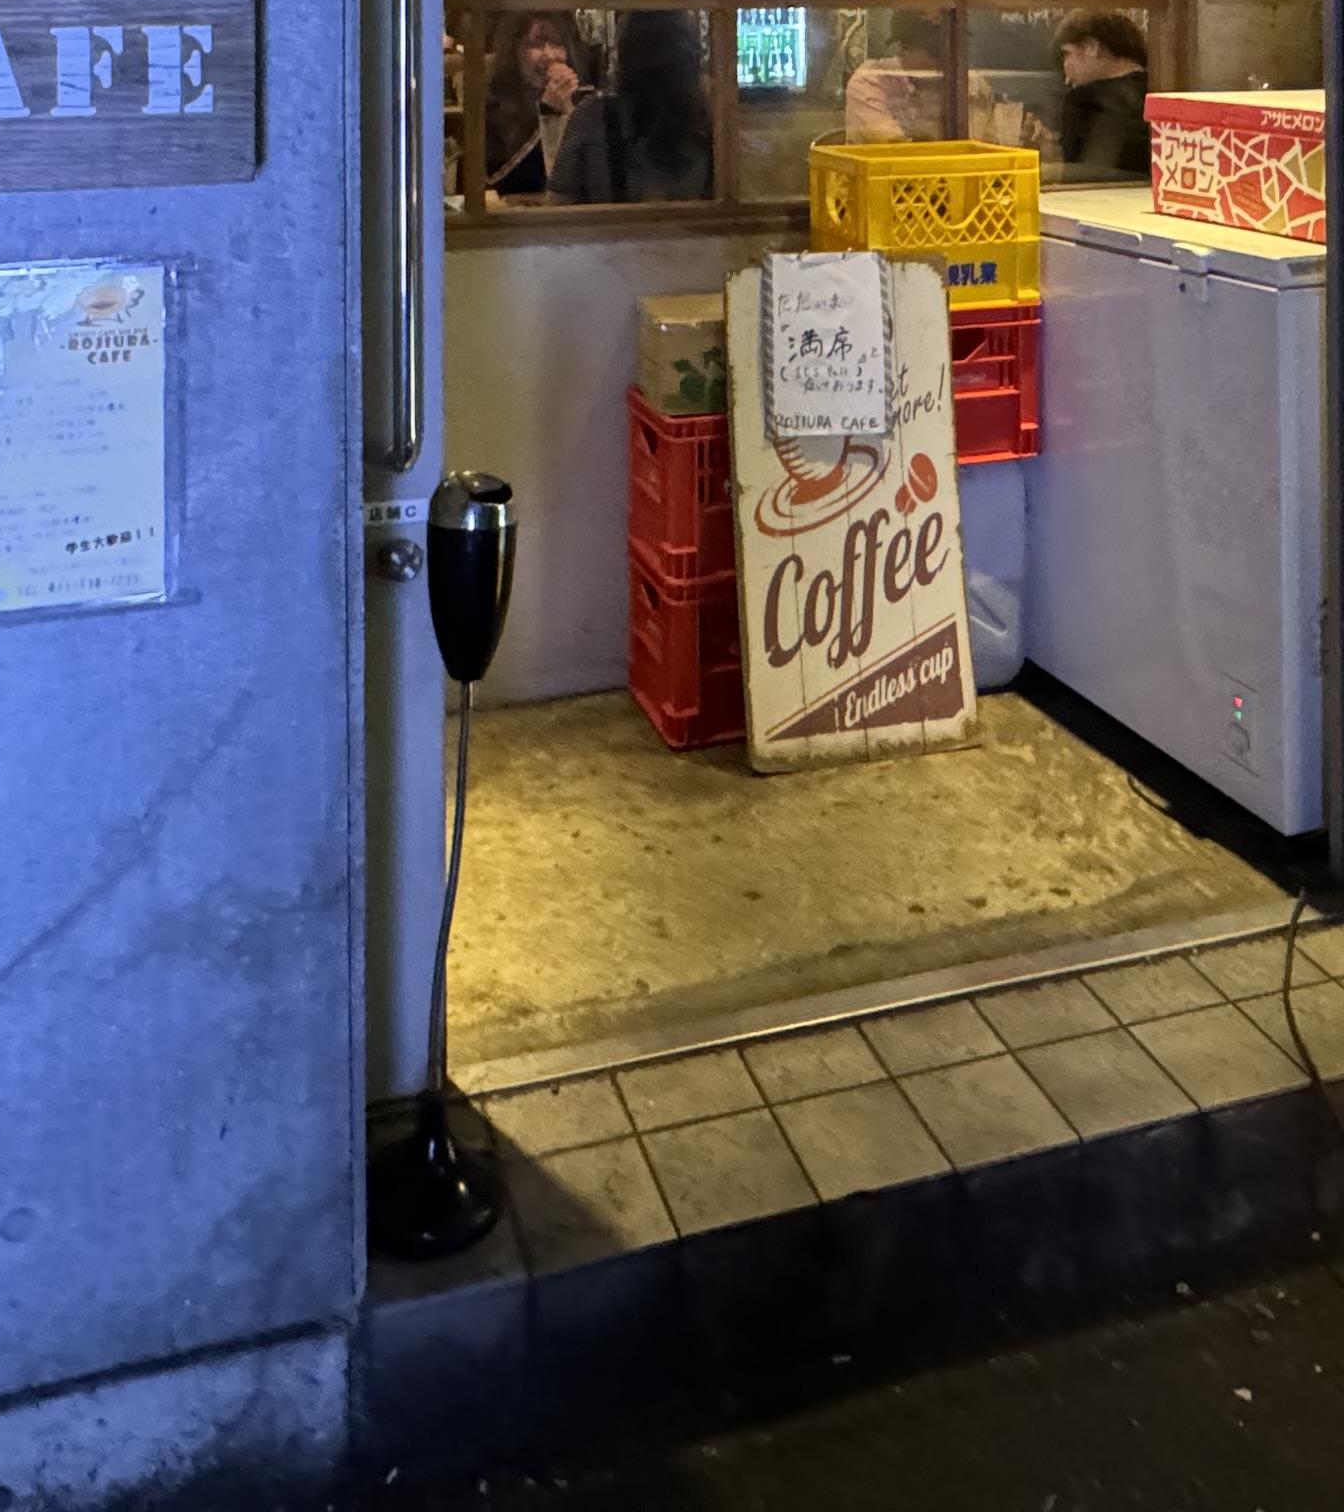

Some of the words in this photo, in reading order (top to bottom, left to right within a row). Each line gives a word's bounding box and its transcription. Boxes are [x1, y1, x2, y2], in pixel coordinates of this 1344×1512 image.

[1260, 109, 1326, 132] アサヒメロン
[1164, 135, 1215, 167] アサヒ
[1164, 161, 1214, 193] メロン
[763, 507, 951, 671] Coffee
[844, 672, 918, 729] Endless
[919, 646, 955, 685] cup
